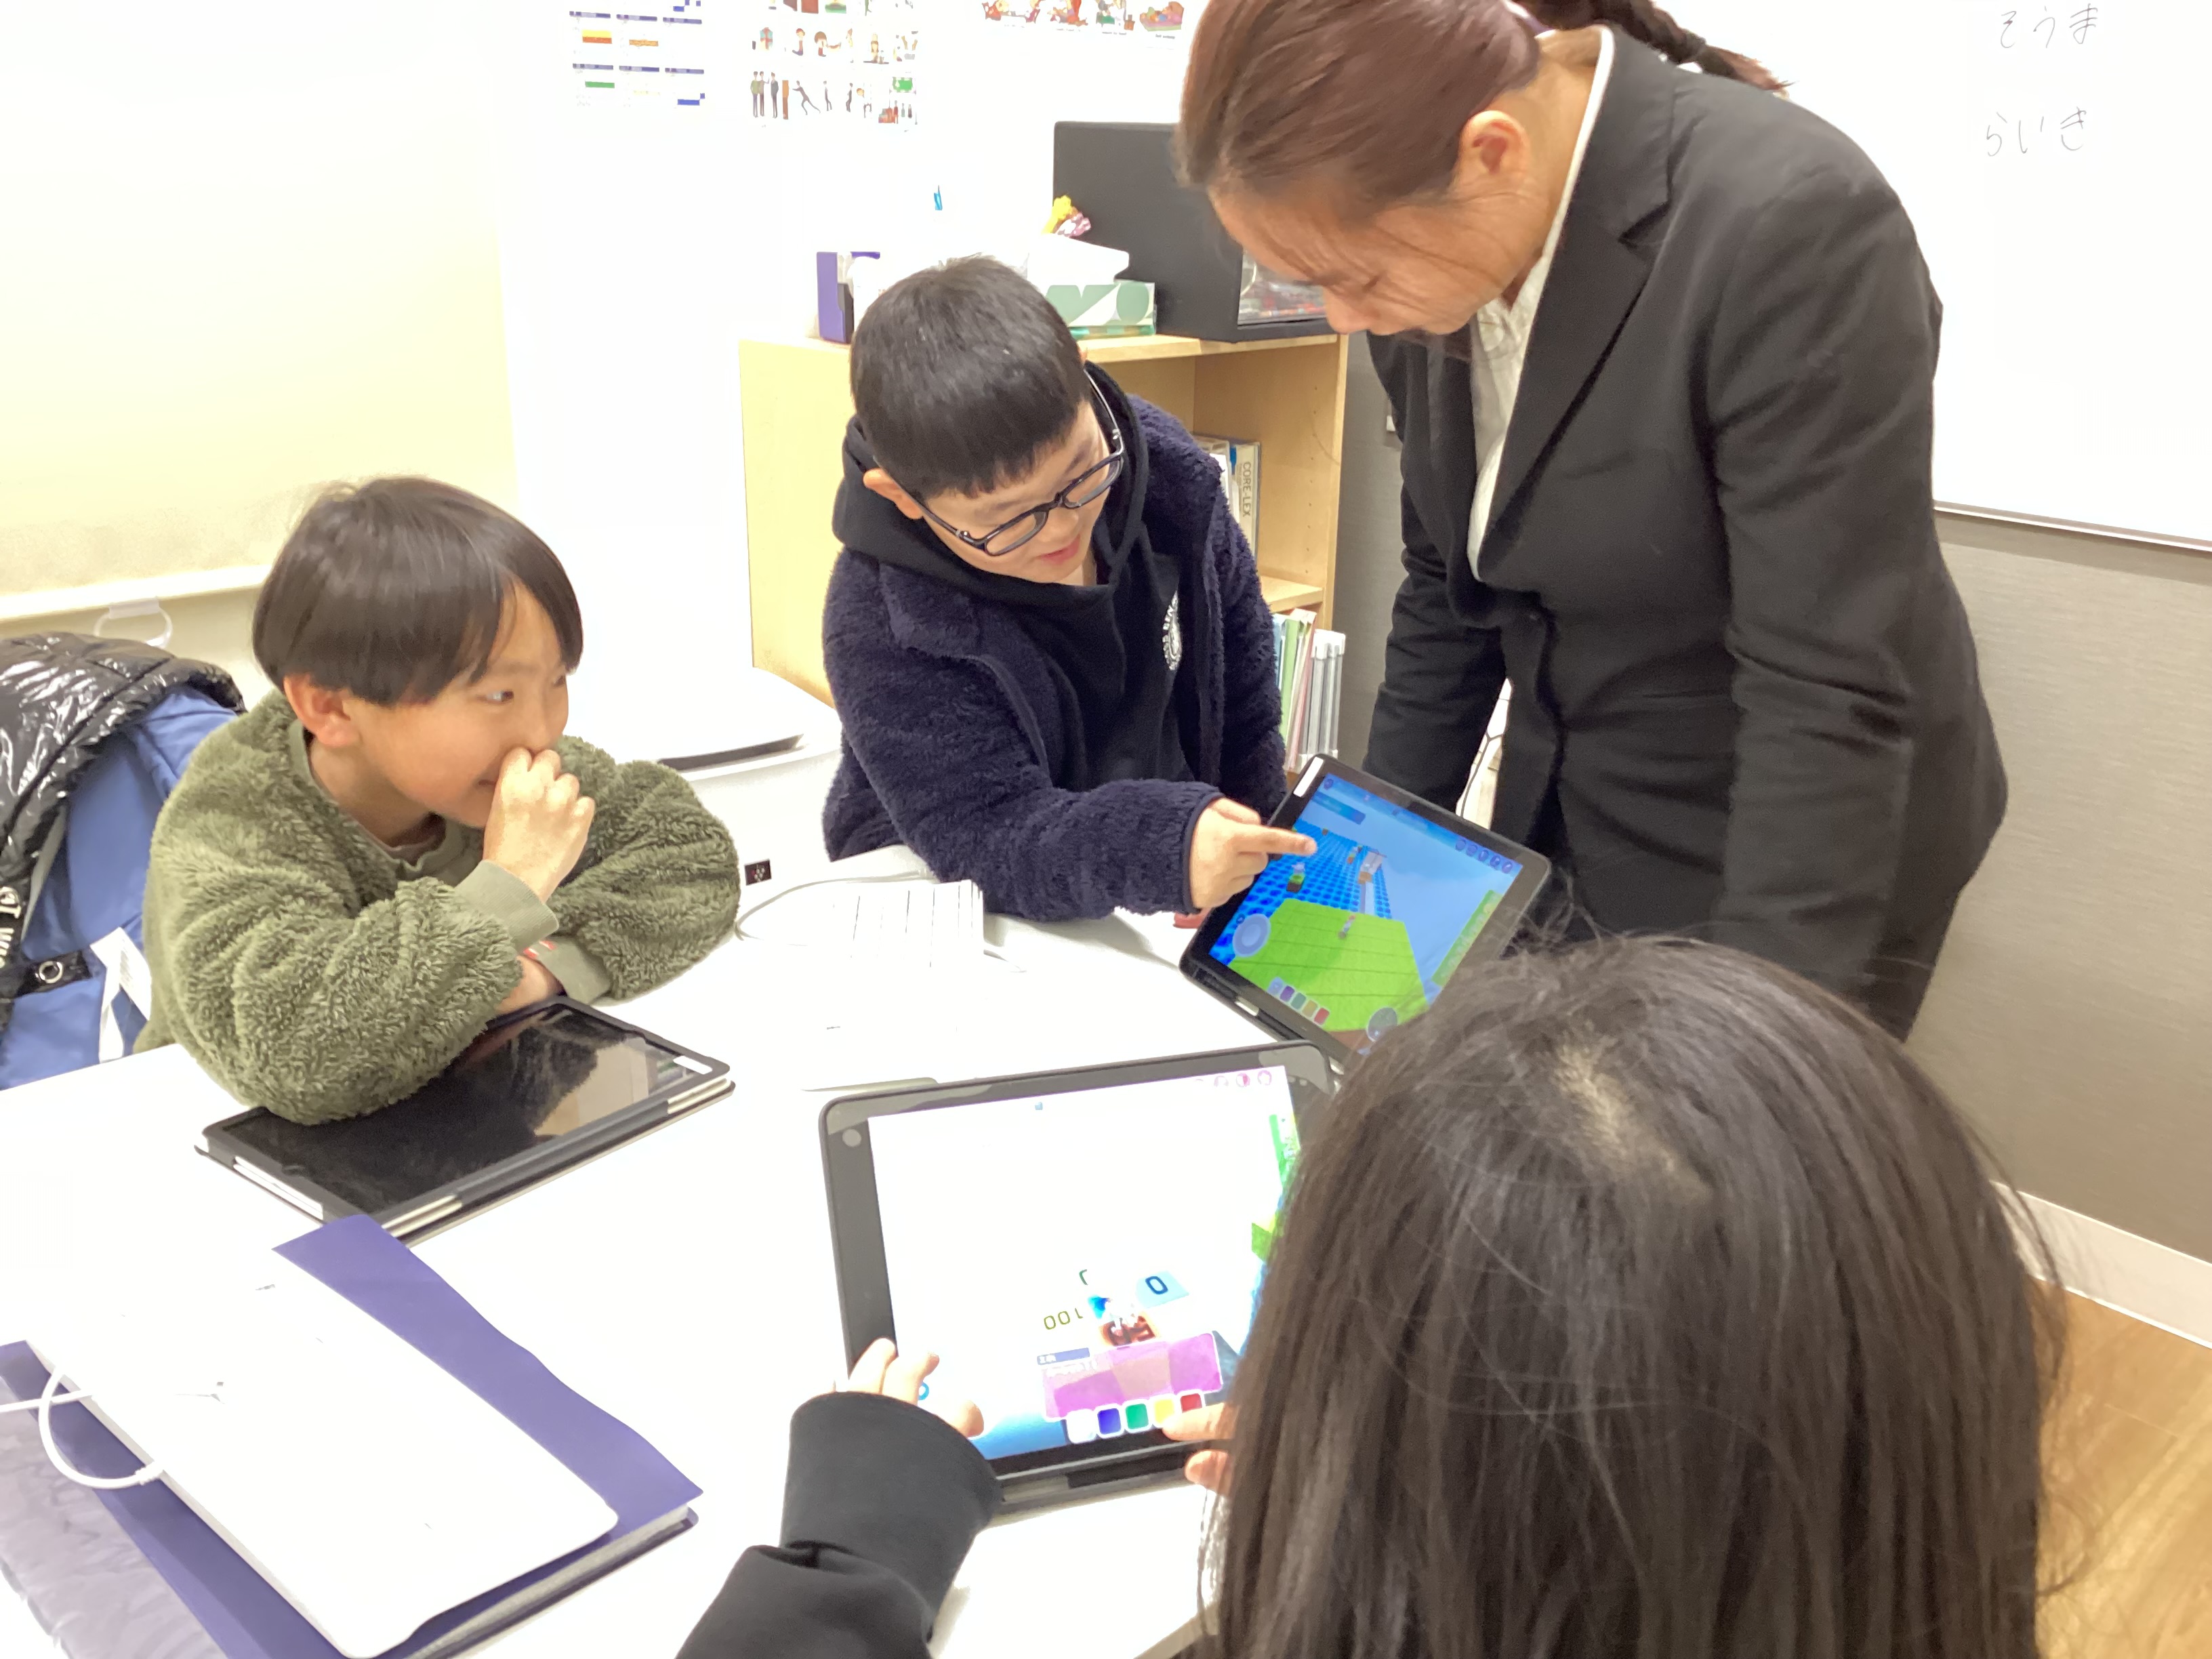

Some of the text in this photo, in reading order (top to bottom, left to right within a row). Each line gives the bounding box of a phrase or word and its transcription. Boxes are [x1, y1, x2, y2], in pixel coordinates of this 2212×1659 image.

[2000, 3, 2098, 48] そうま
[1986, 106, 2087, 157] らいき
[1242, 462, 1252, 517] CORE-LEX
